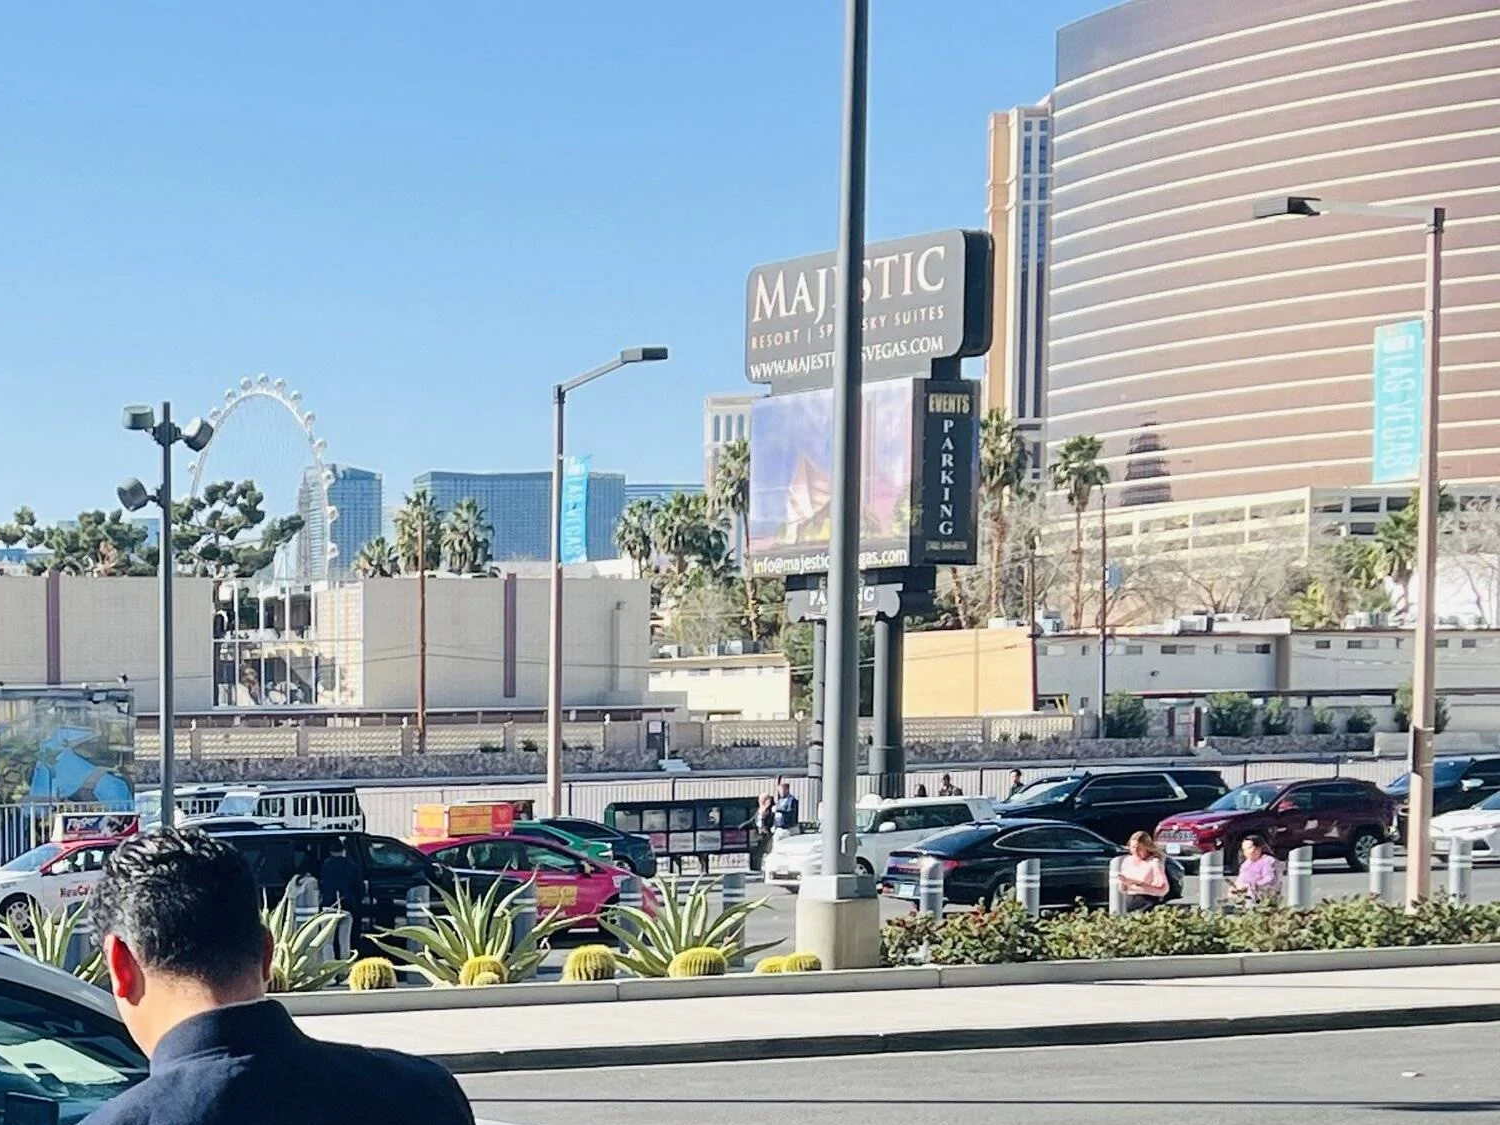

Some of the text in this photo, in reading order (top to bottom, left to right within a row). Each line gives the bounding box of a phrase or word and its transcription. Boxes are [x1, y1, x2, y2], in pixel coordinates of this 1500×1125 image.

[752, 246, 945, 325] MAJSTIC
[751, 304, 944, 350] RESORT SP SKY SUITES
[928, 392, 970, 413] EVENTS
[1380, 398, 1416, 469] VEGAS
[939, 419, 955, 536] PARKING
